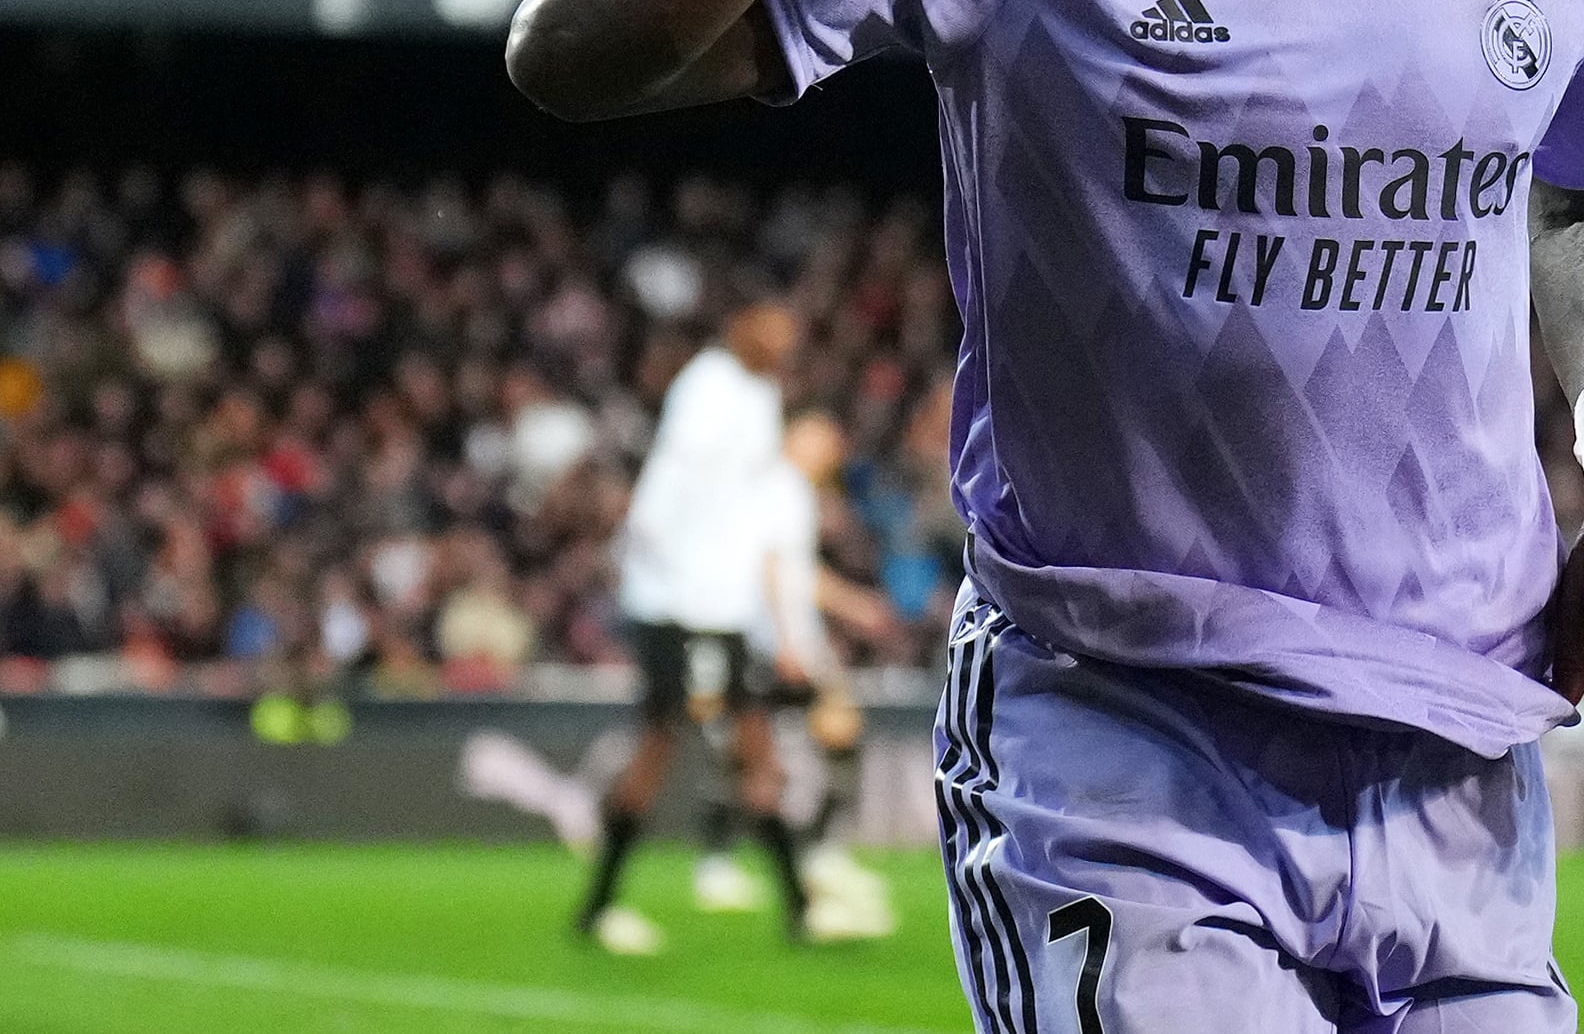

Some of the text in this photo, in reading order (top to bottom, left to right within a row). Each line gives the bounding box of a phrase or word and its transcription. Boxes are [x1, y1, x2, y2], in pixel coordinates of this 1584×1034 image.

[1129, 18, 1231, 44] adidas
[1122, 115, 1530, 222] Emirates
[1182, 229, 1477, 313] FLY BETTER
[1047, 894, 1114, 1034] 7
